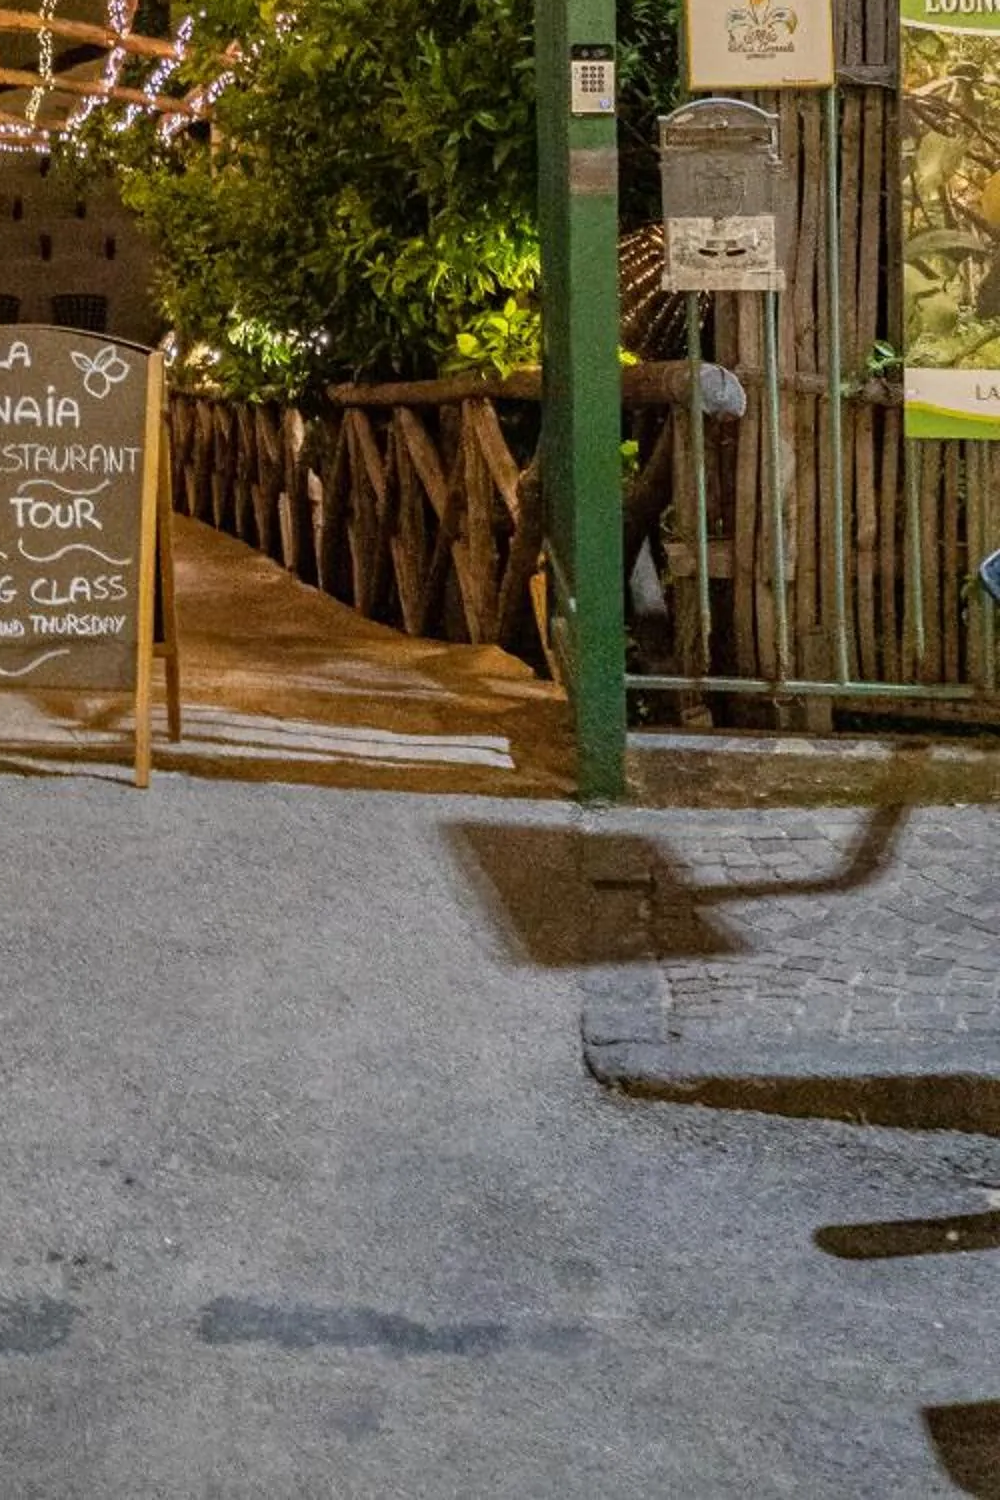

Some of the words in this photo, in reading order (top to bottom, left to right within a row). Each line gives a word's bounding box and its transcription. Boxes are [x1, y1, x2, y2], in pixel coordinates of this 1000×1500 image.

[9, 498, 103, 530] TOUR
[30, 575, 128, 605] CLASS
[29, 614, 127, 636] THURSDAY
